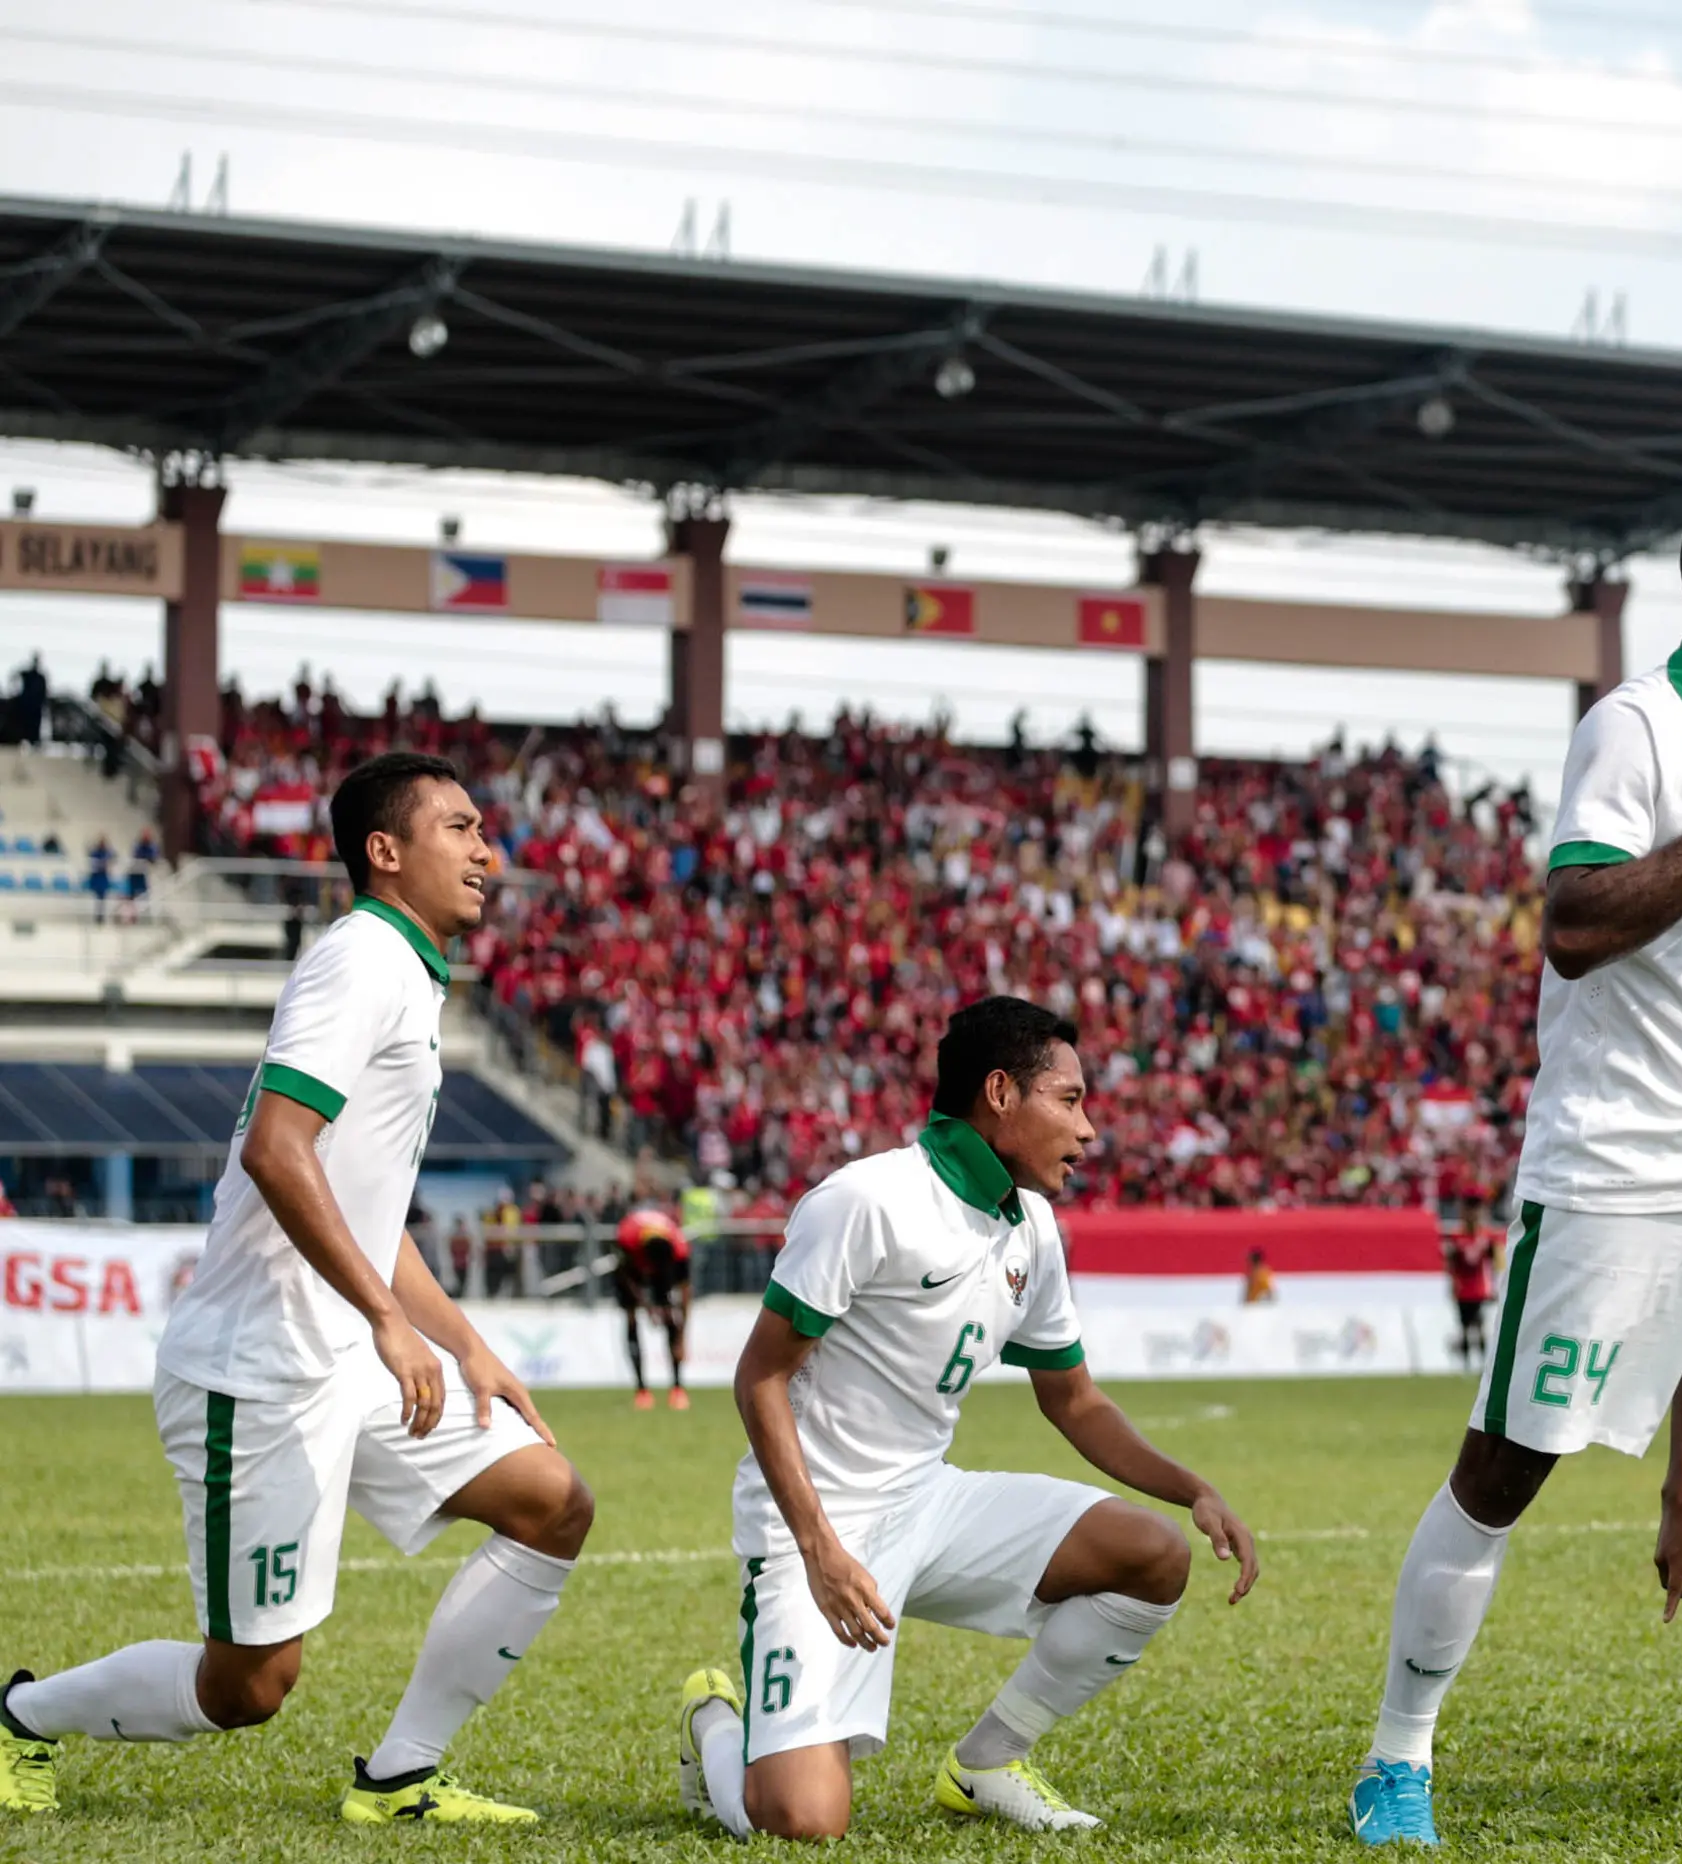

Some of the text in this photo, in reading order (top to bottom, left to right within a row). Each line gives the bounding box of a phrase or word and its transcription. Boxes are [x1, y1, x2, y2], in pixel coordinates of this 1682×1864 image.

[18, 532, 157, 582] SELAYANG
[4, 1253, 143, 1317] GSA
[936, 1320, 987, 1394] 6
[1531, 1333, 1624, 1408] 24
[248, 1540, 300, 1608] 15
[761, 1646, 796, 1715] 6
